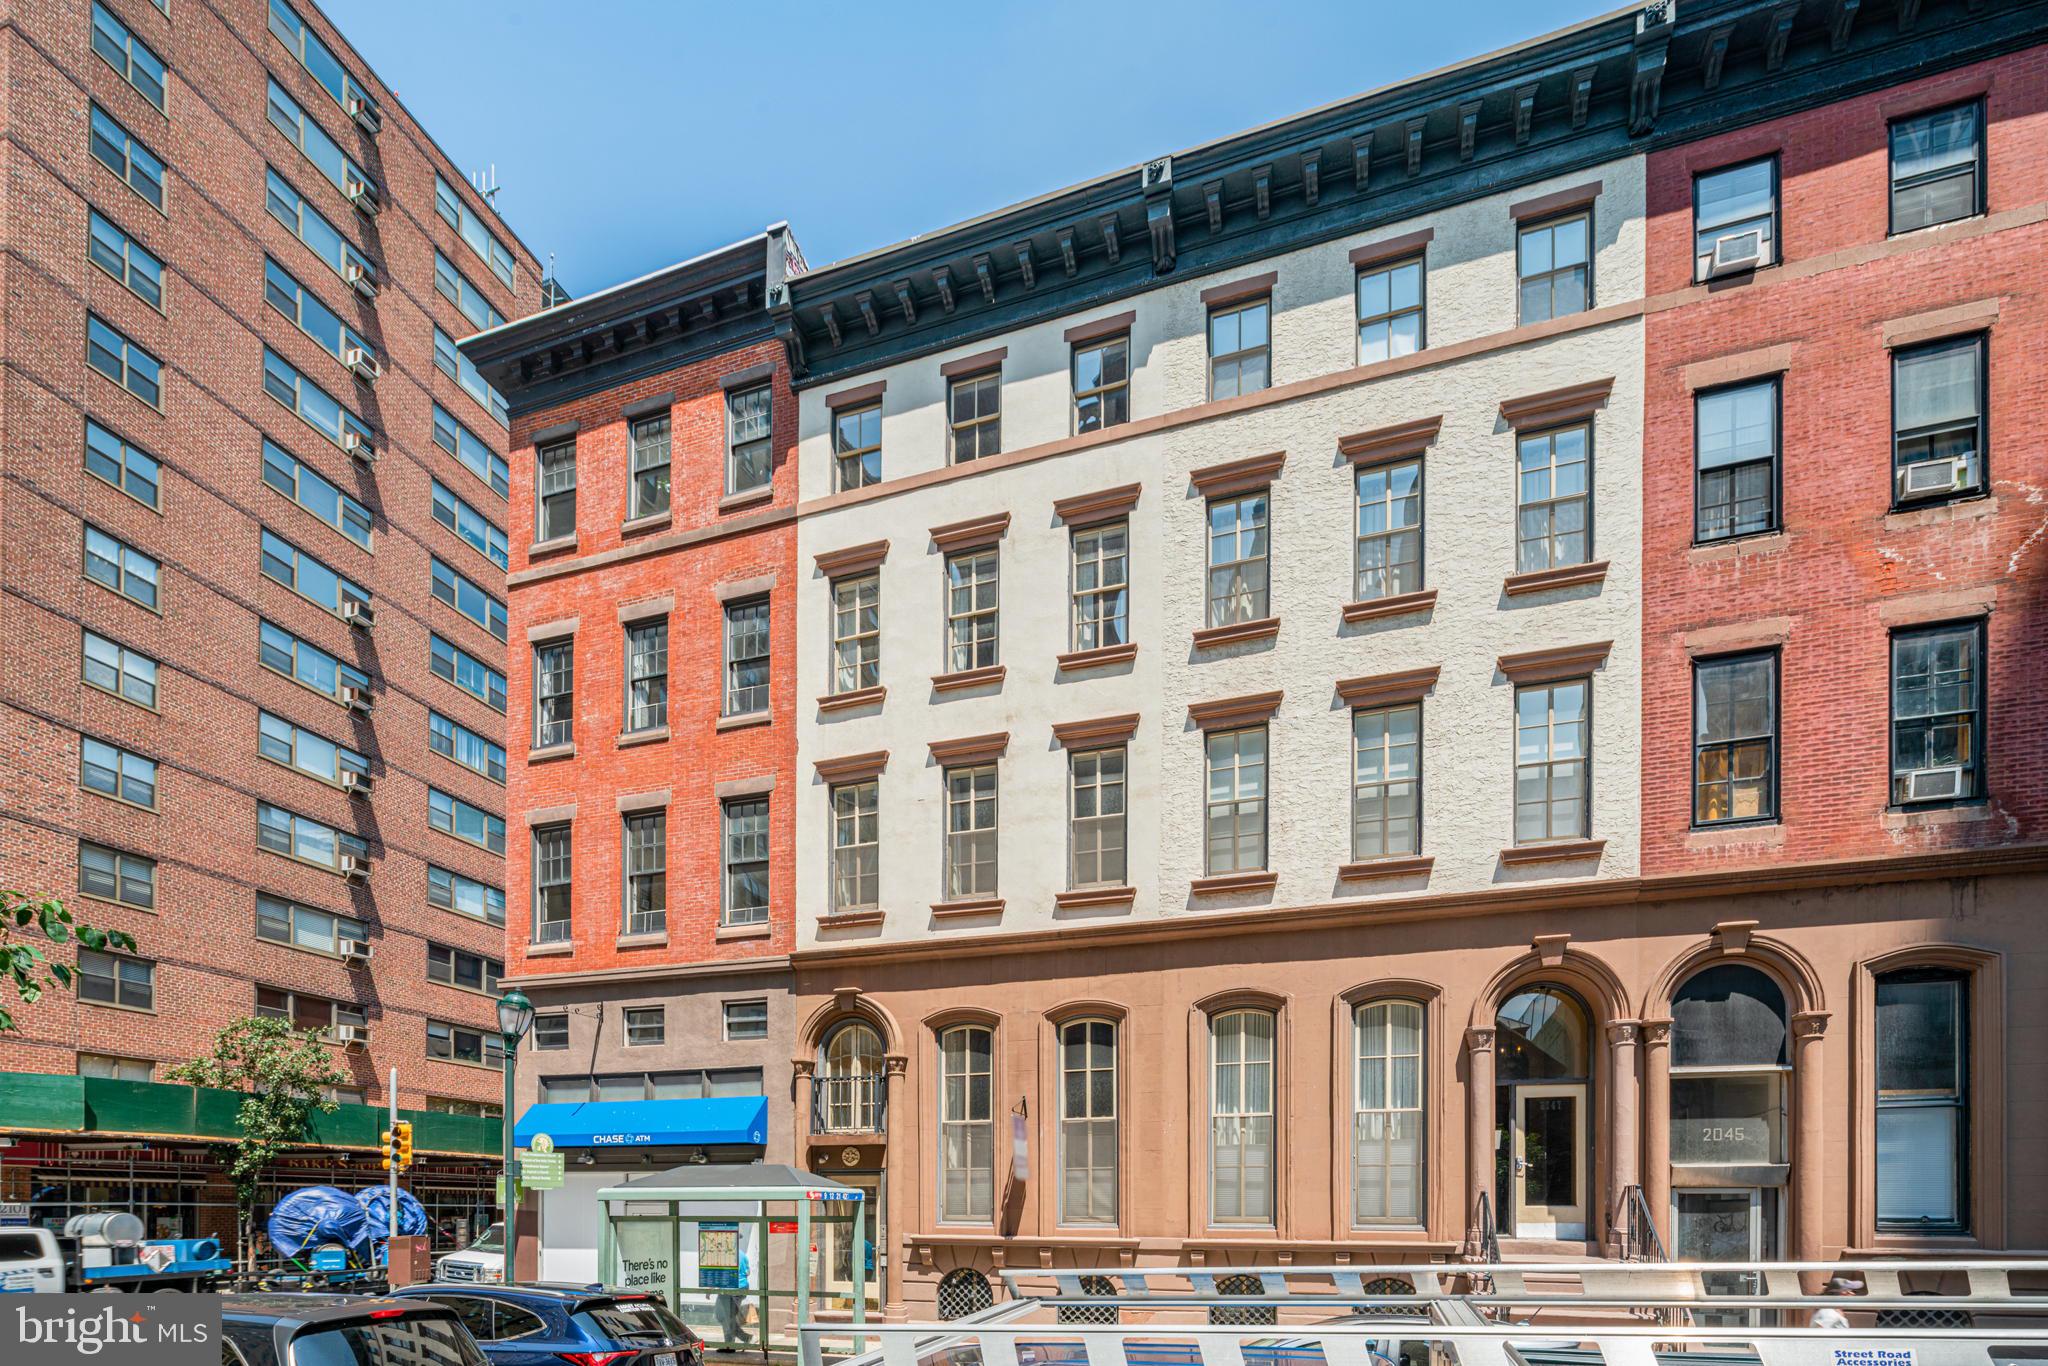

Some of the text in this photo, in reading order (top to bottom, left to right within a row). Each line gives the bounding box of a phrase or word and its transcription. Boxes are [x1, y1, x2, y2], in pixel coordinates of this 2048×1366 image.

[593, 1134, 624, 1144] CHASE
[1703, 1127, 1745, 1142] 2045
[622, 1258, 669, 1272] There's no
[625, 1272, 666, 1287] place like
[1834, 1350, 1912, 1359] Street Road
[1836, 1358, 1912, 1366] Accessories
